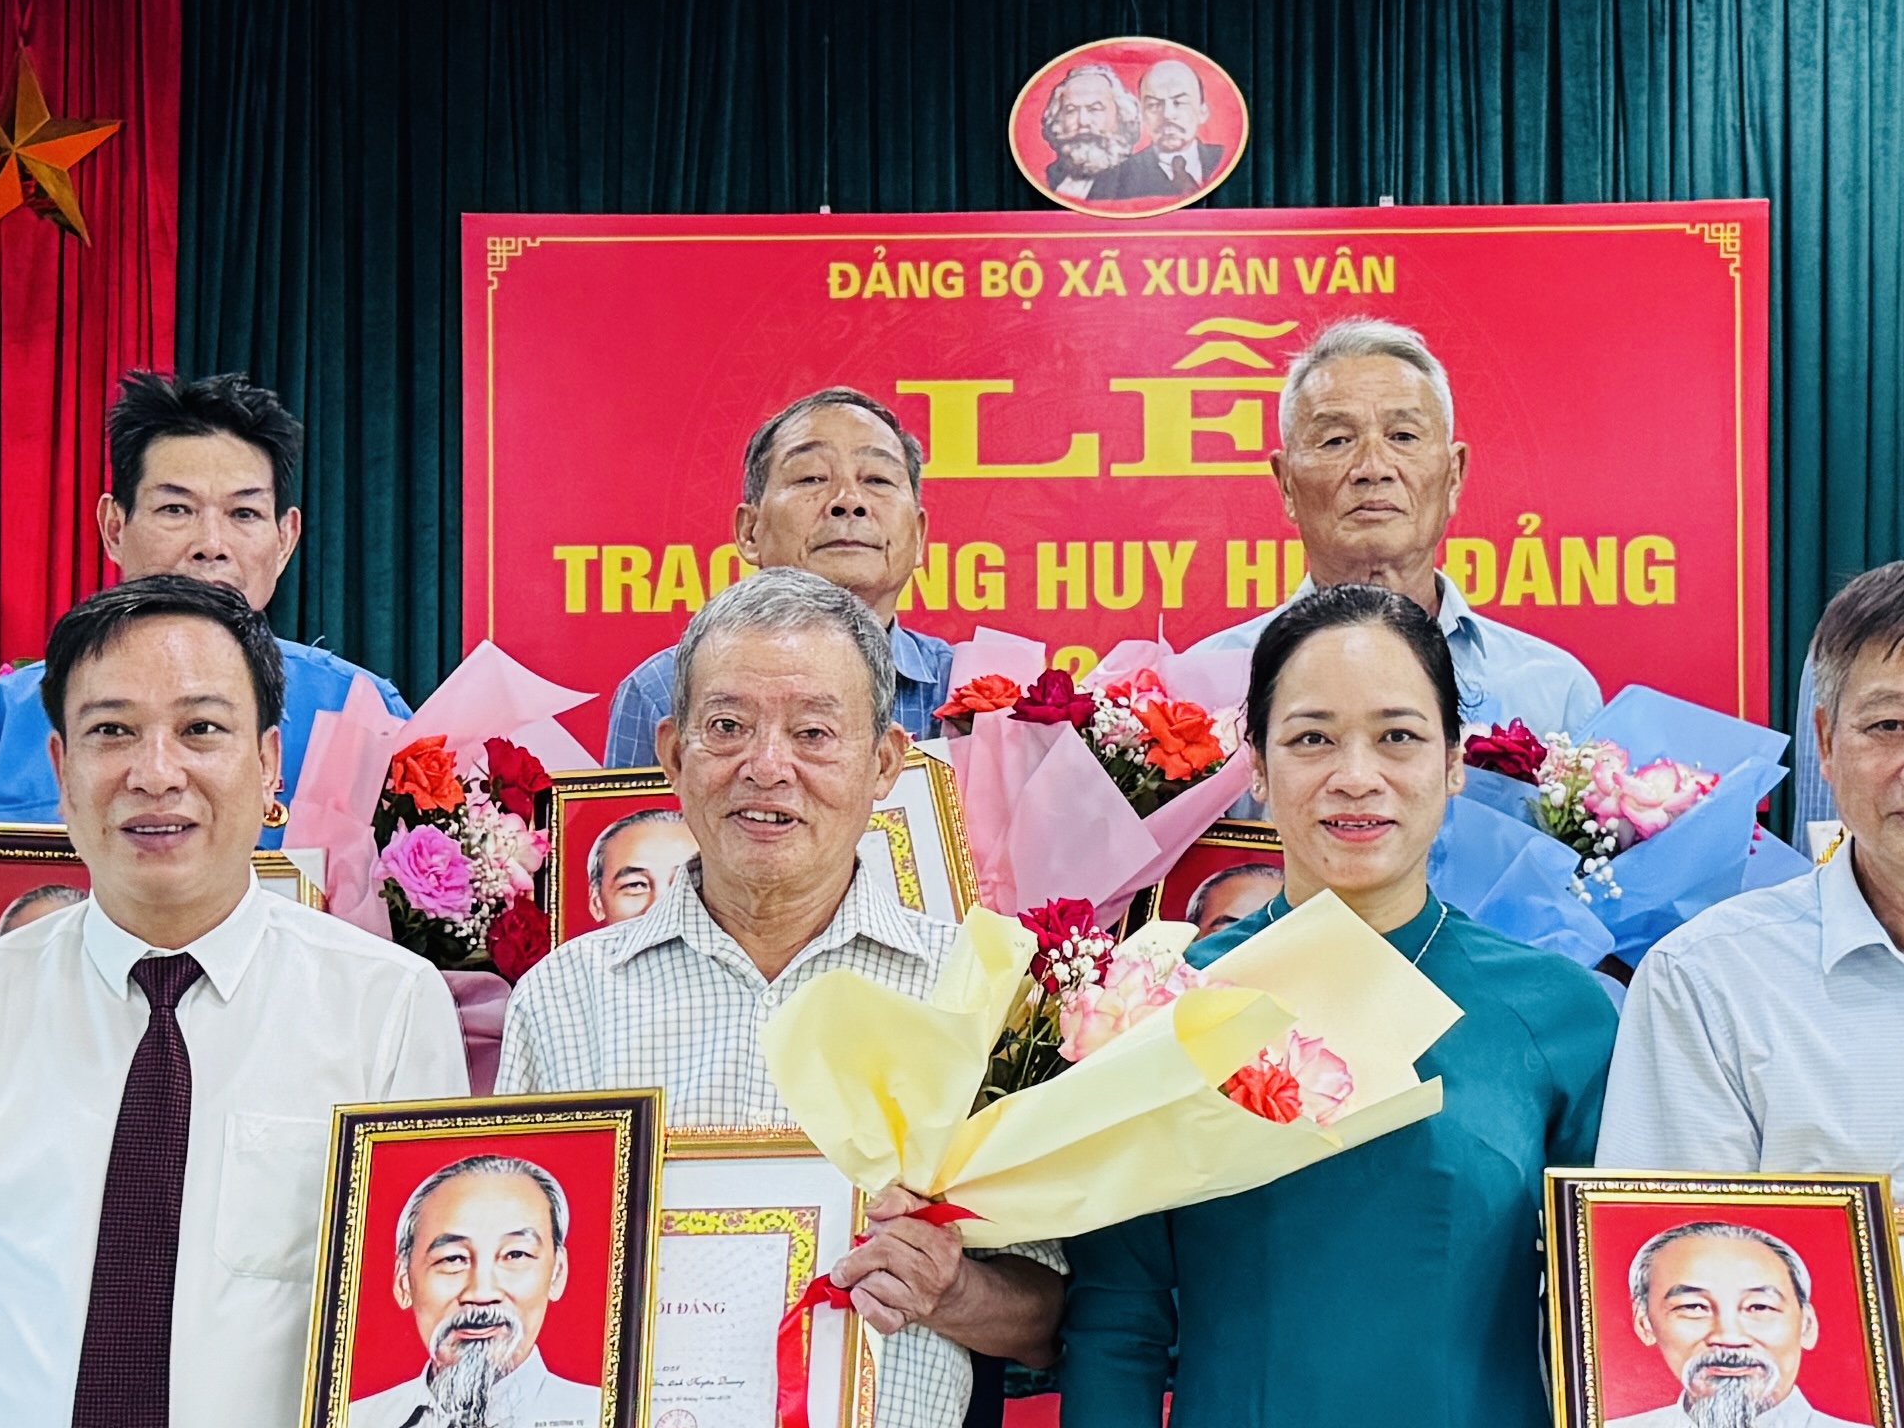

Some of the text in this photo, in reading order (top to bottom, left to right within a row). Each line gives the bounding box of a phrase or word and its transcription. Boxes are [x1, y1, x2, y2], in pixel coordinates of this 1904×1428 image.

[827, 245, 1395, 310] ĐẢNG BỘ XÃ XUÂN VÂN
[896, 317, 1300, 479] LỄ
[1037, 540, 1198, 611] HUY
[1226, 540, 1307, 609] HI
[1442, 513, 1676, 606] ĐẢNG
